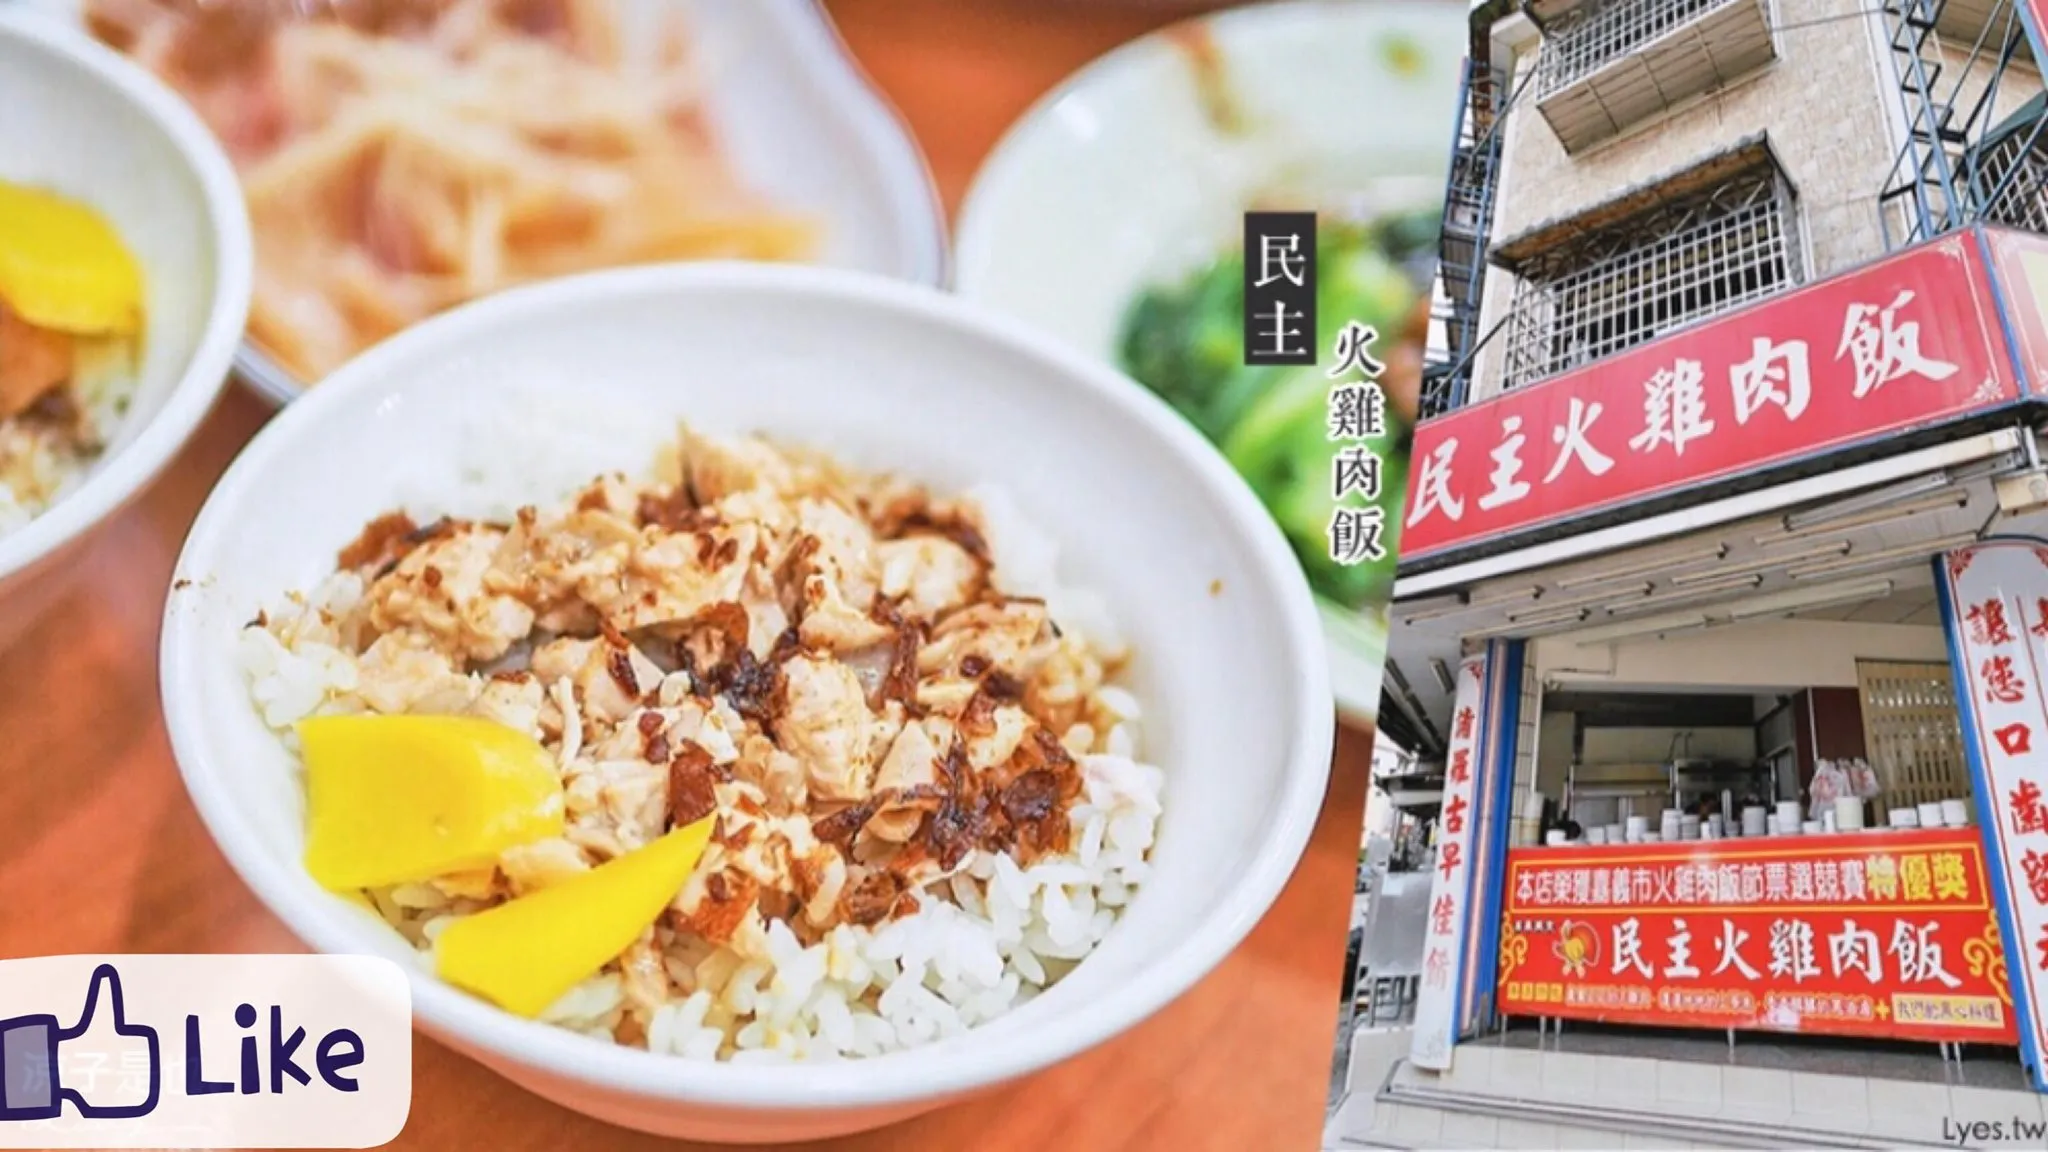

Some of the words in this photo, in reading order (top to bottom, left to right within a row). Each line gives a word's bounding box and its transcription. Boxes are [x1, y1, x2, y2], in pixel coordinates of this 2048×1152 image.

[1405, 289, 1959, 530] 民主火雞肉飯
[1610, 917, 1963, 988] 民主火雞肉飯
